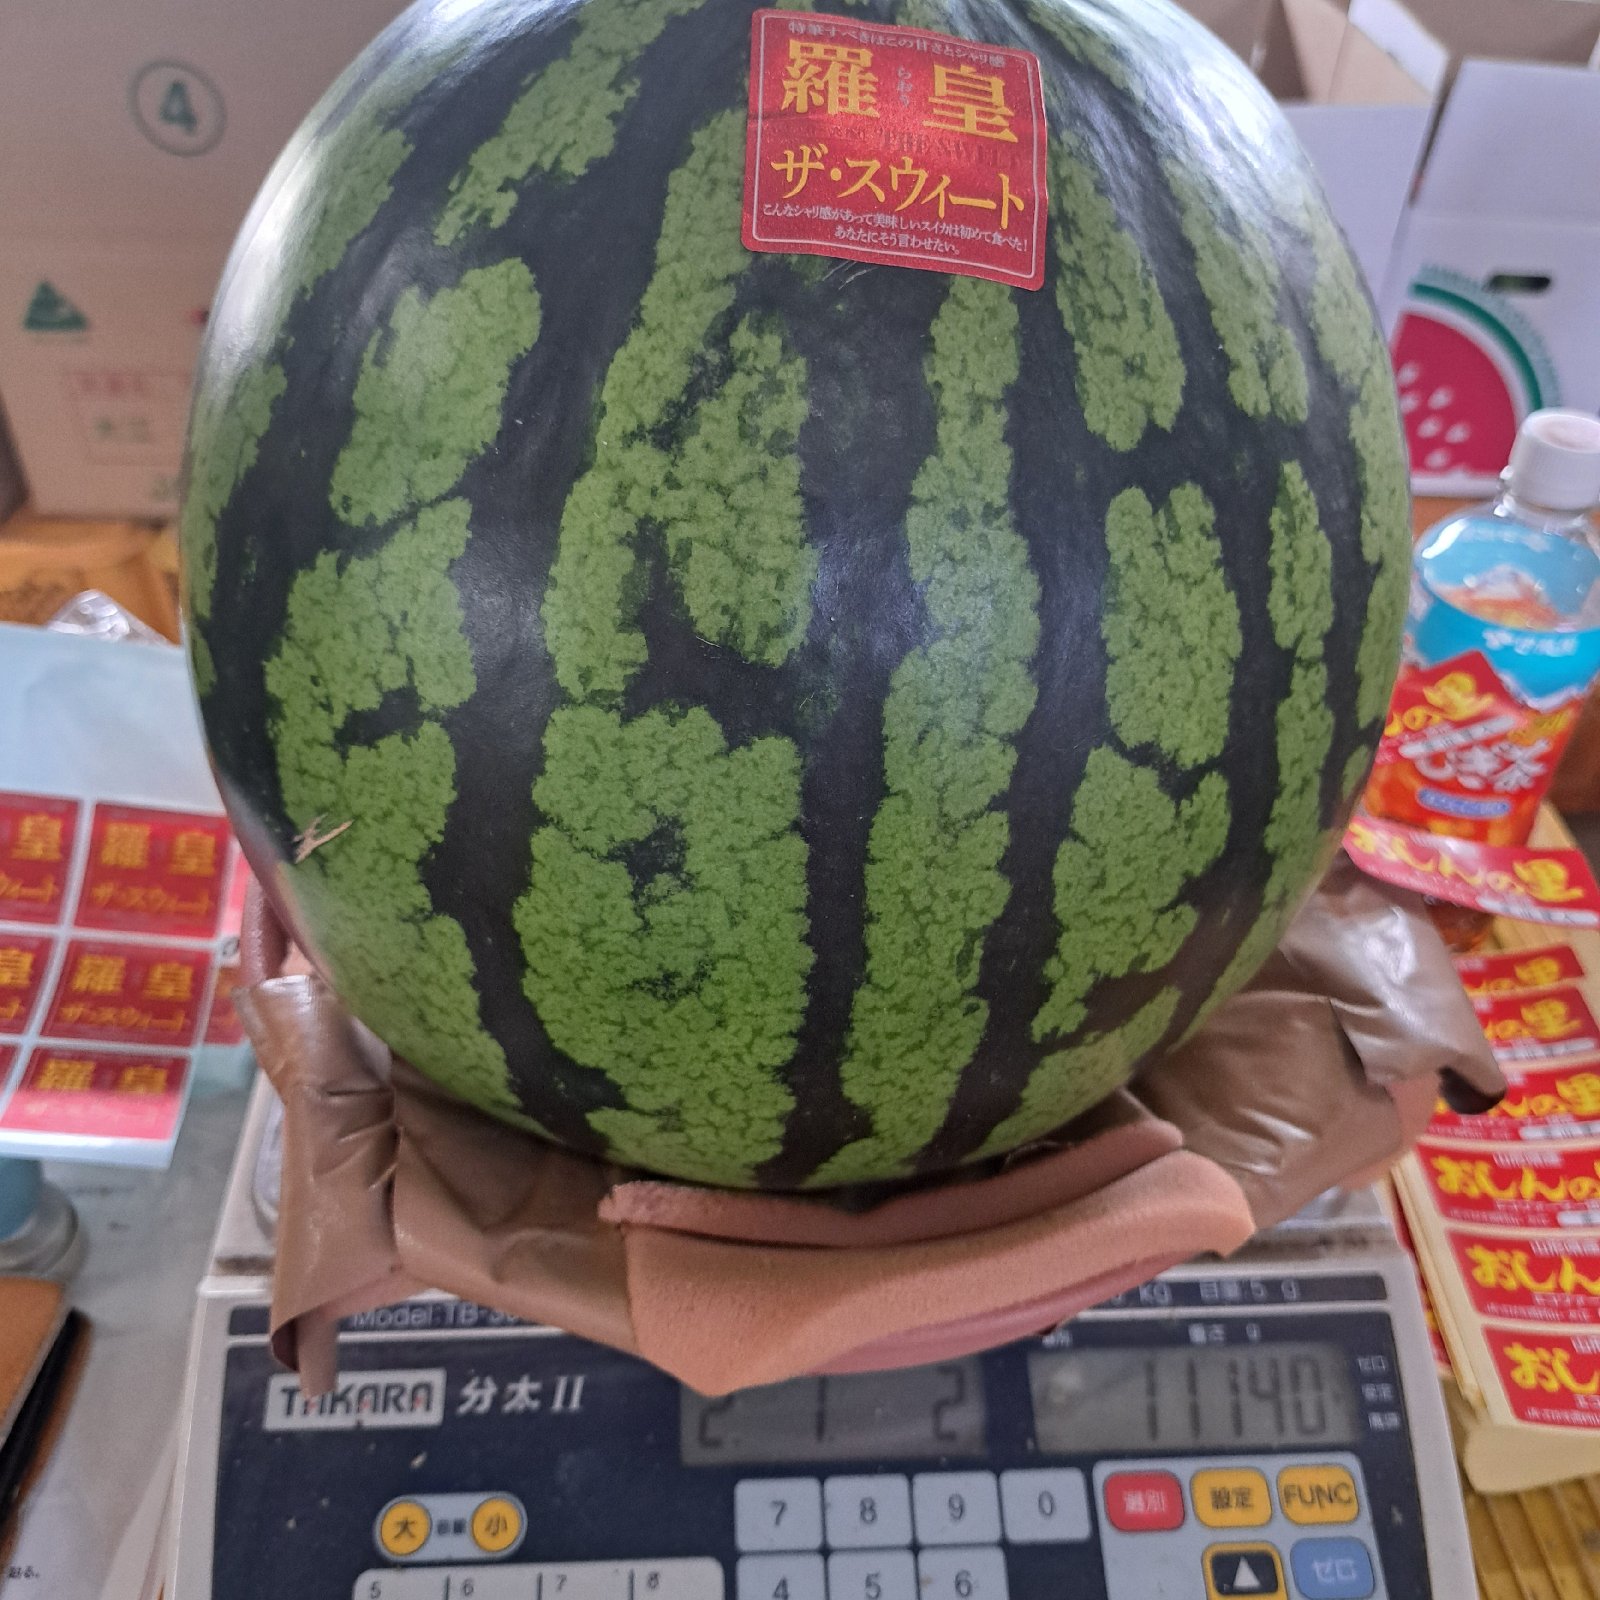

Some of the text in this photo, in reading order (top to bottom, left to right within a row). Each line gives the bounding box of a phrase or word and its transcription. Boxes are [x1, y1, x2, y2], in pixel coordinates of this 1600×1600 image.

[932, 1365, 965, 1442] 2
[947, 1493, 966, 1521] 9
[1038, 1490, 1056, 1517] 0
[1281, 1482, 1353, 1509] FUNC
[768, 1499, 788, 1527] 7
[858, 1496, 879, 1525] 8
[393, 1517, 417, 1540] 大
[484, 1512, 509, 1537] 小
[556, 1574, 568, 1592] 7
[953, 1568, 973, 1599] 6
[1311, 1558, 1358, 1583] ゼロ
[369, 1581, 382, 1600] 5
[462, 1578, 475, 1597] 6
[771, 1576, 791, 1600] 4
[864, 1572, 883, 1600] 5
